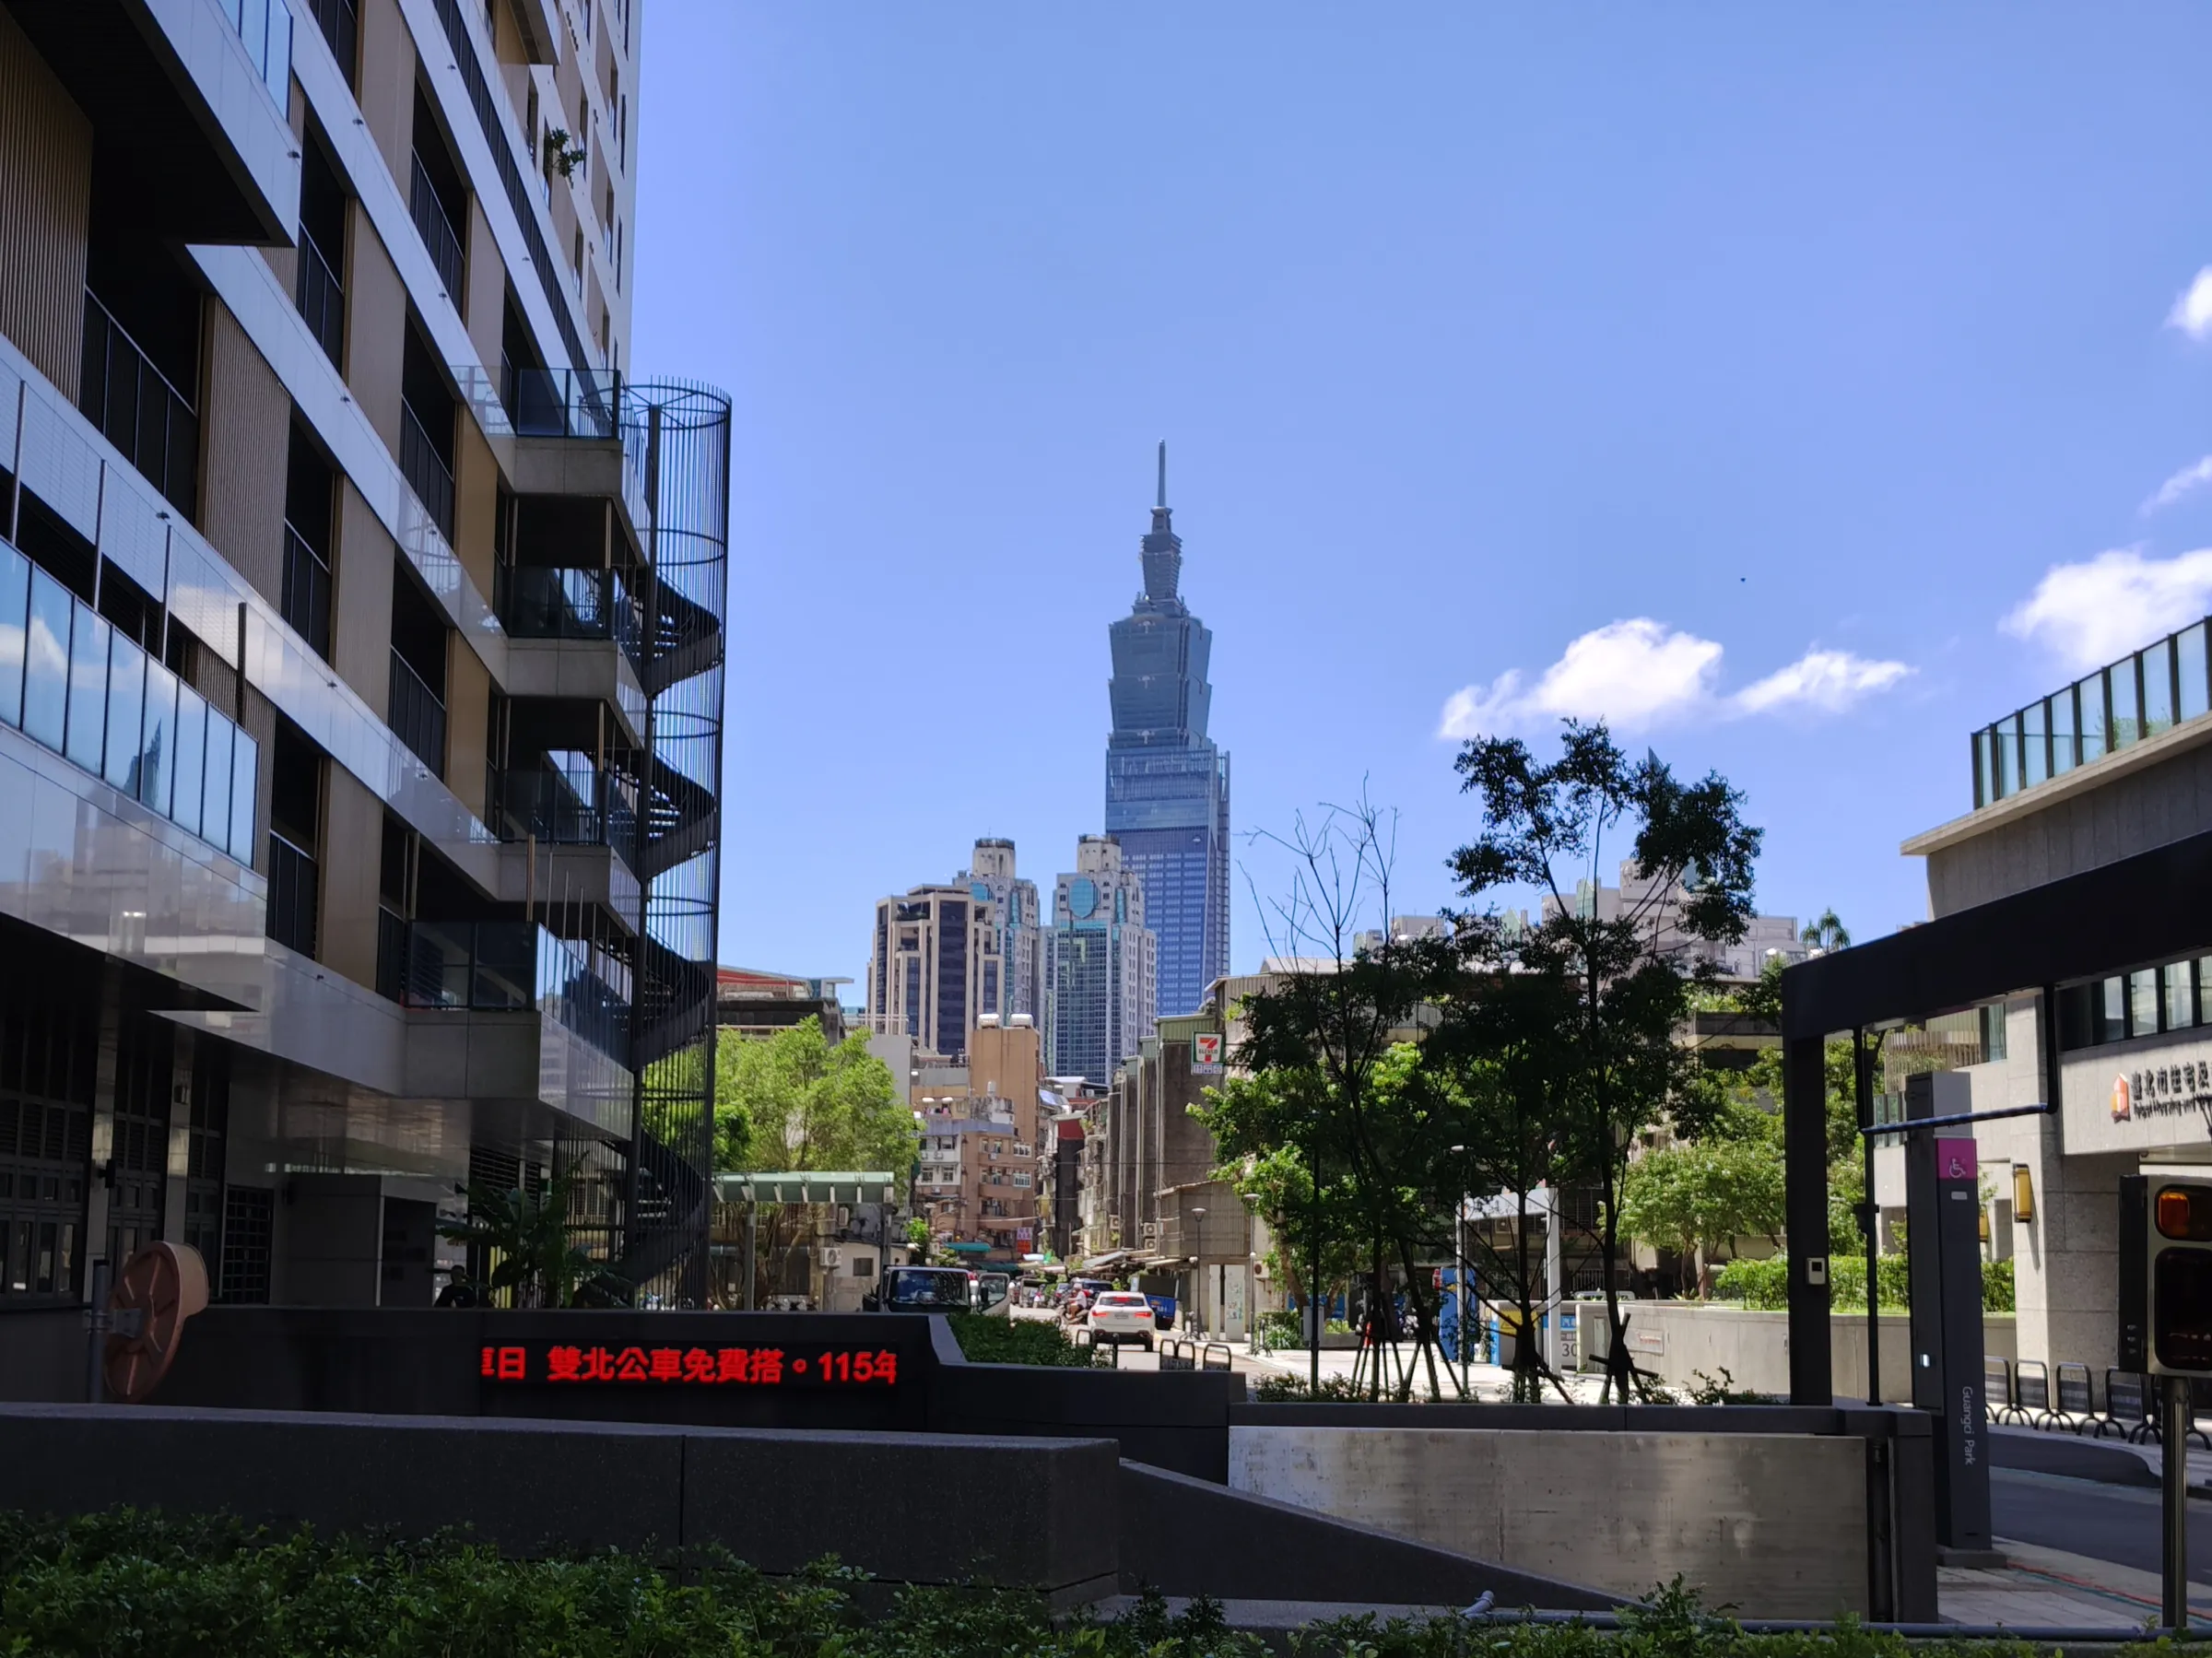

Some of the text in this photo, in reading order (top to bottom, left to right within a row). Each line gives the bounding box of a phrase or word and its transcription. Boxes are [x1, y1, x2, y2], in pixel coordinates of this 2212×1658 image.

[2131, 1061, 2212, 1101] 臺北市住宅及
[1959, 1385, 1977, 1466] Guangci Park
